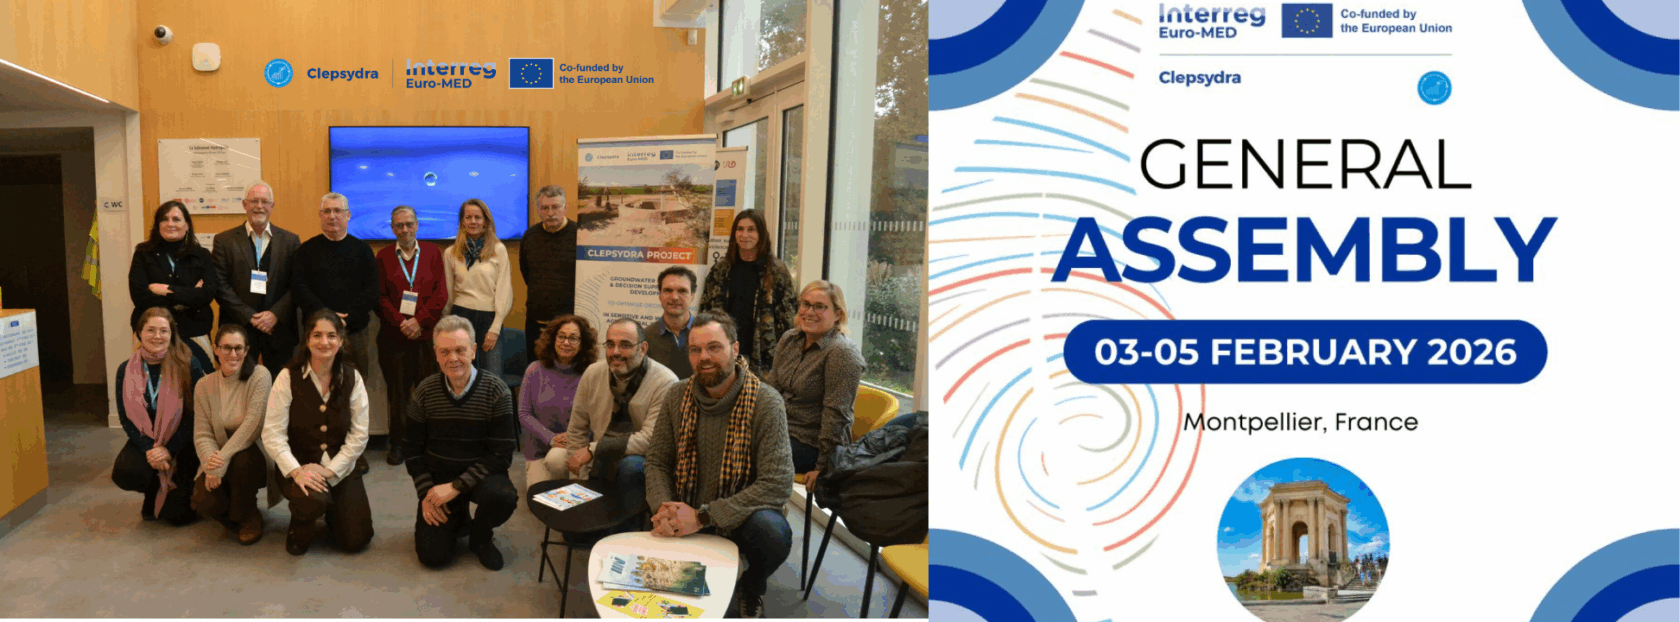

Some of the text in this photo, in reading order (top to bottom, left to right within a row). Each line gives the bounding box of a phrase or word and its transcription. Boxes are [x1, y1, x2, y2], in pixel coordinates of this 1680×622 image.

[587, 249, 692, 260] CLEPSYDRA PROJECT
[610, 276, 656, 284] GROUNDWATER
